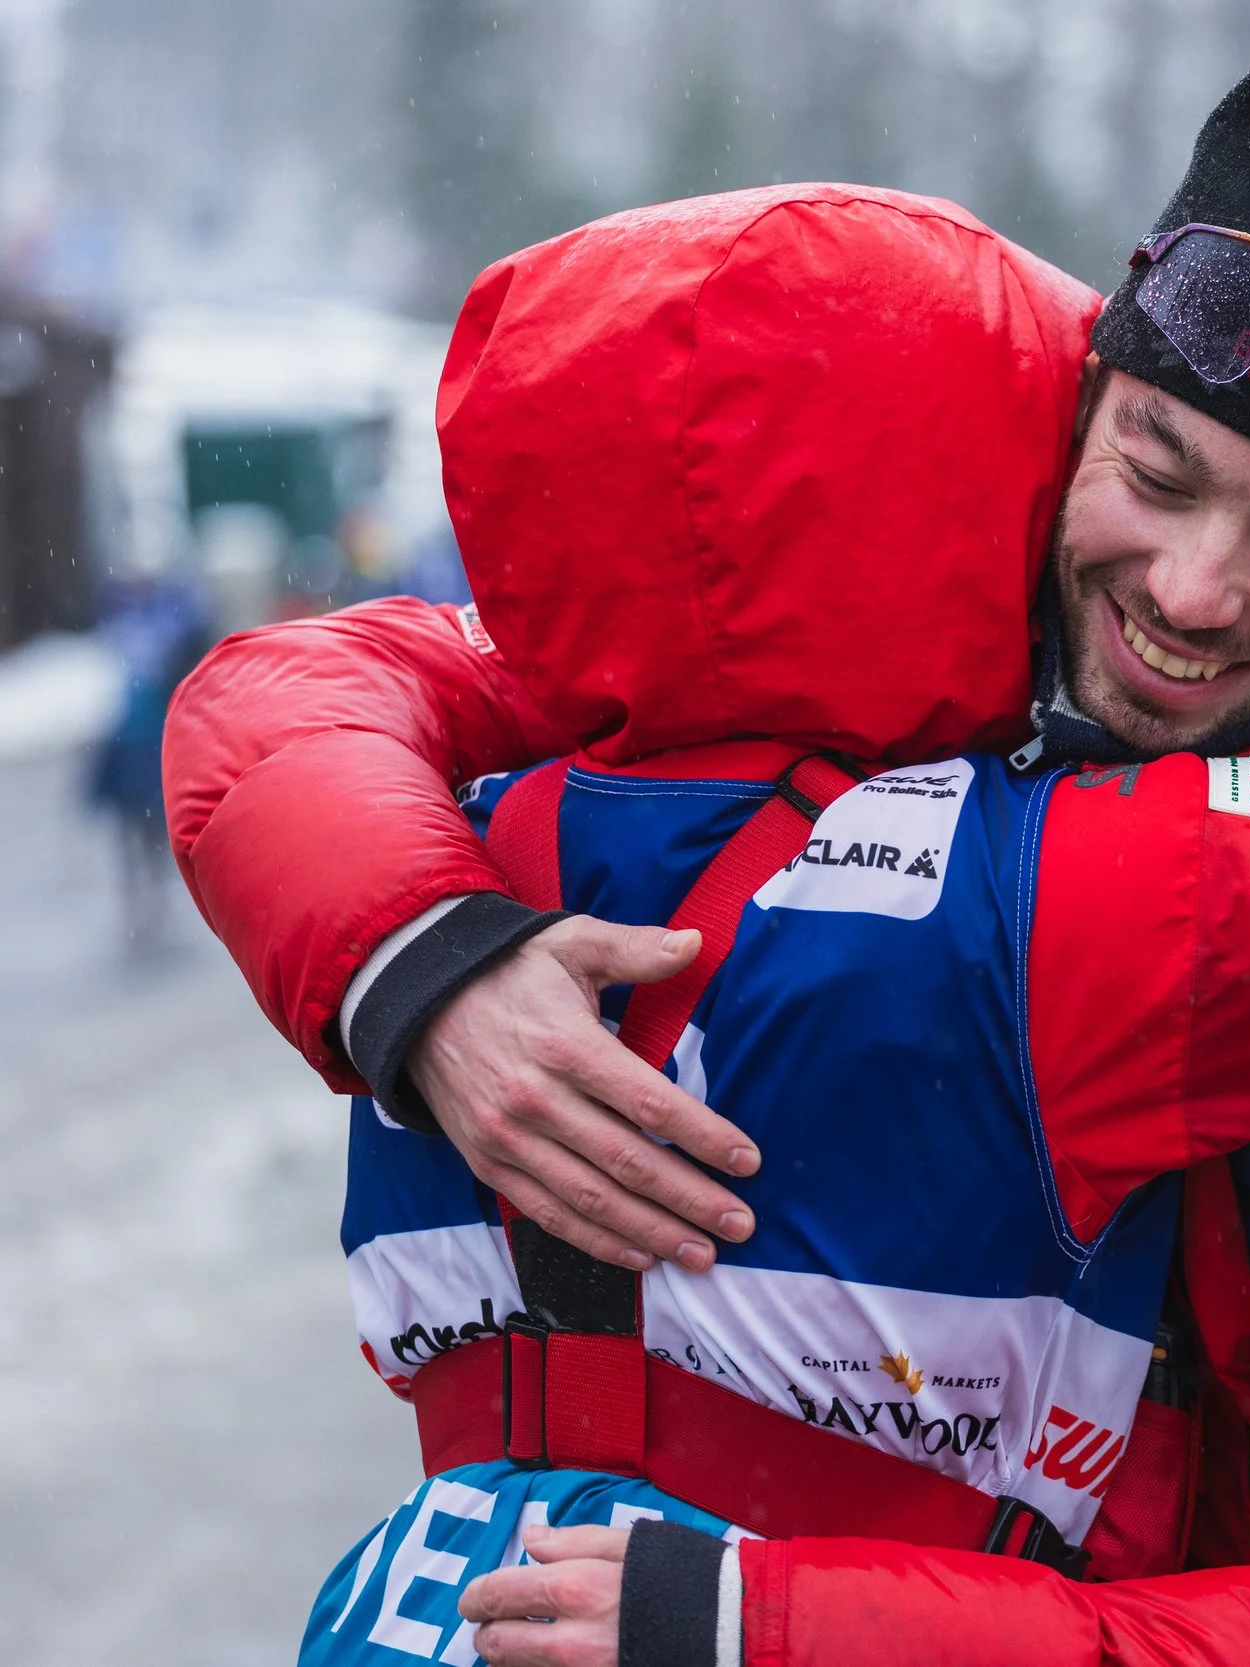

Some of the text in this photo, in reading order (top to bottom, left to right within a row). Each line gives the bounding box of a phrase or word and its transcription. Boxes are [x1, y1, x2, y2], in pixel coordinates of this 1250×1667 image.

[863, 785, 886, 793] Pro
[888, 786, 930, 796] Roller
[1231, 768, 1239, 802] GESTION
[784, 839, 901, 873] CLAIR
[801, 1356, 1000, 1390] CAPITAL MARKETS
